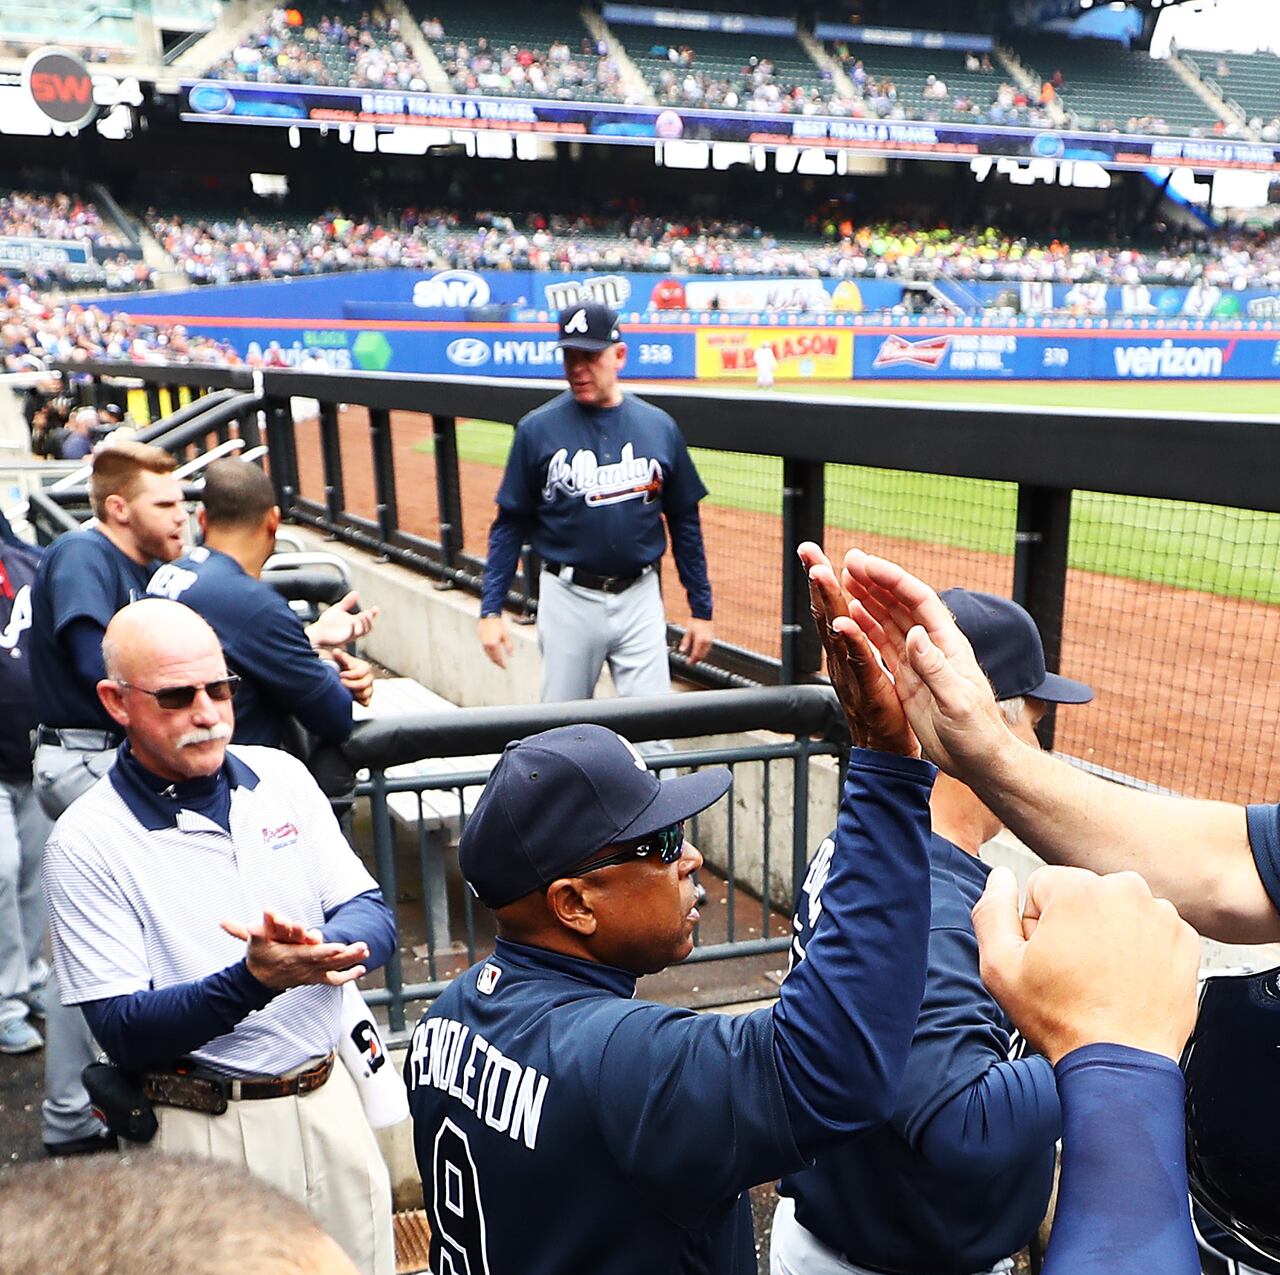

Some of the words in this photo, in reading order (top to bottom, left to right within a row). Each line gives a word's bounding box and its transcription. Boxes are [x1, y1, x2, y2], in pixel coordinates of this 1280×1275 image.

[638, 343, 674, 364] 358
[1113, 338, 1223, 377] verizon
[542, 441, 649, 502] Atlanta
